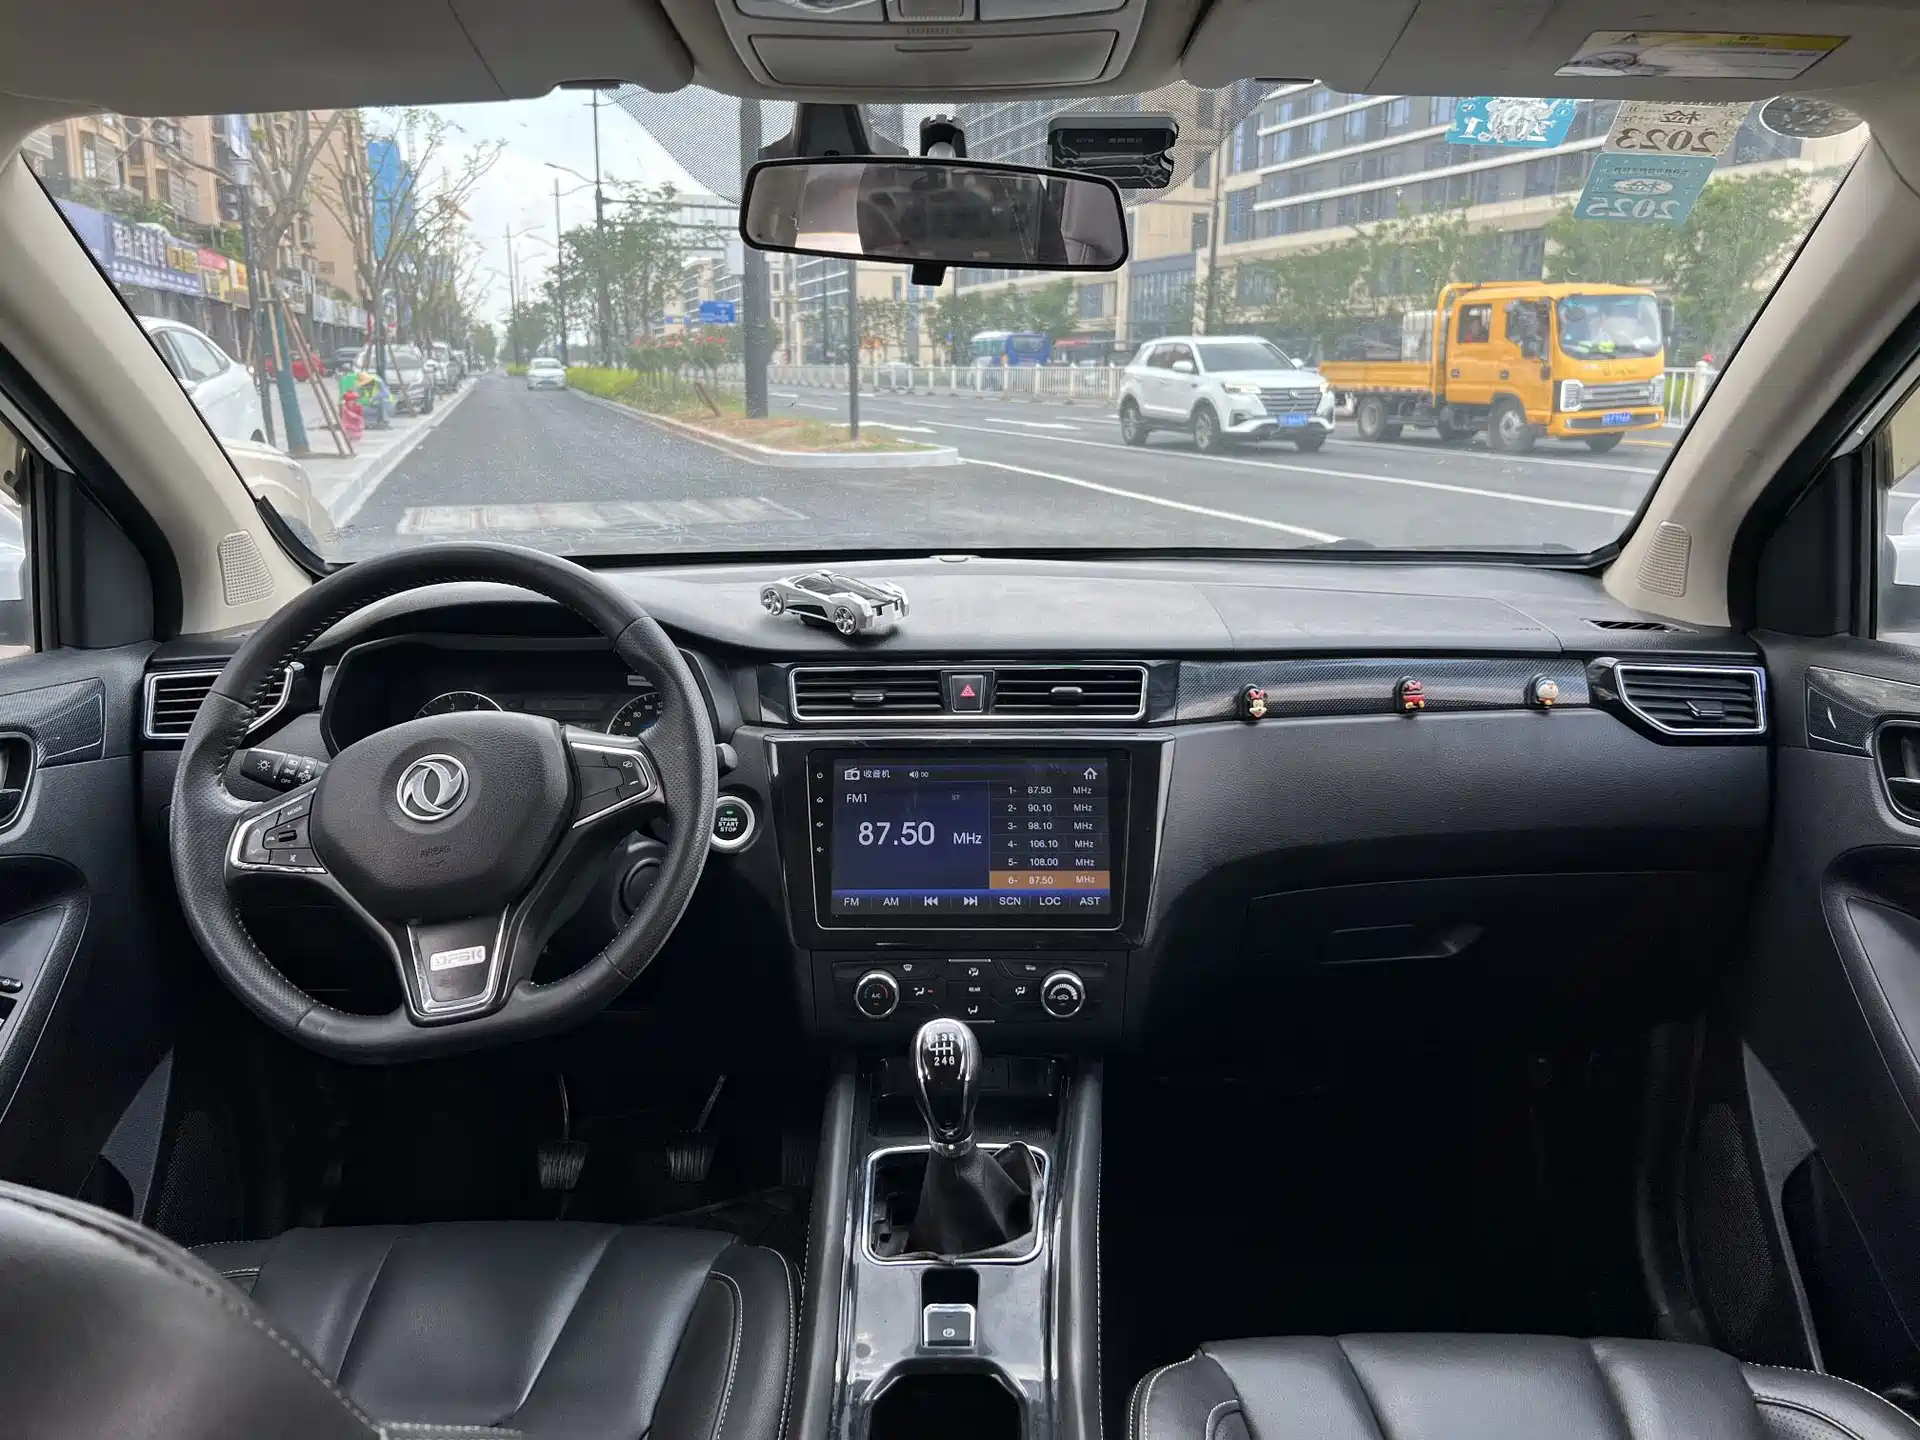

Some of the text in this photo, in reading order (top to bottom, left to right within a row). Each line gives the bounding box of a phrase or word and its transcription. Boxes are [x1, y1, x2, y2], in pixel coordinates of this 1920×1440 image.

[863, 769, 891, 779] 收音机
[1028, 786, 1052, 794] 87.50
[846, 793, 868, 803] FM1
[1028, 804, 1052, 812] 90.10
[1074, 804, 1092, 812] MHz
[1028, 822, 1052, 830] 98.10
[1074, 822, 1093, 830] MHz
[858, 821, 983, 846] 87.50 MHz
[1030, 840, 1058, 848] 106.10
[1074, 840, 1094, 848] MHz
[420, 844, 451, 858] AIRBAG
[1030, 858, 1058, 866] 108.00
[1075, 858, 1095, 867] MHz
[1029, 876, 1053, 884] 87.50
[1076, 876, 1095, 884] MHz
[844, 896, 860, 906] FM
[883, 896, 899, 906] AM
[999, 897, 1021, 906] SCN
[1039, 897, 1061, 906] LOC
[1079, 897, 1101, 906] AST
